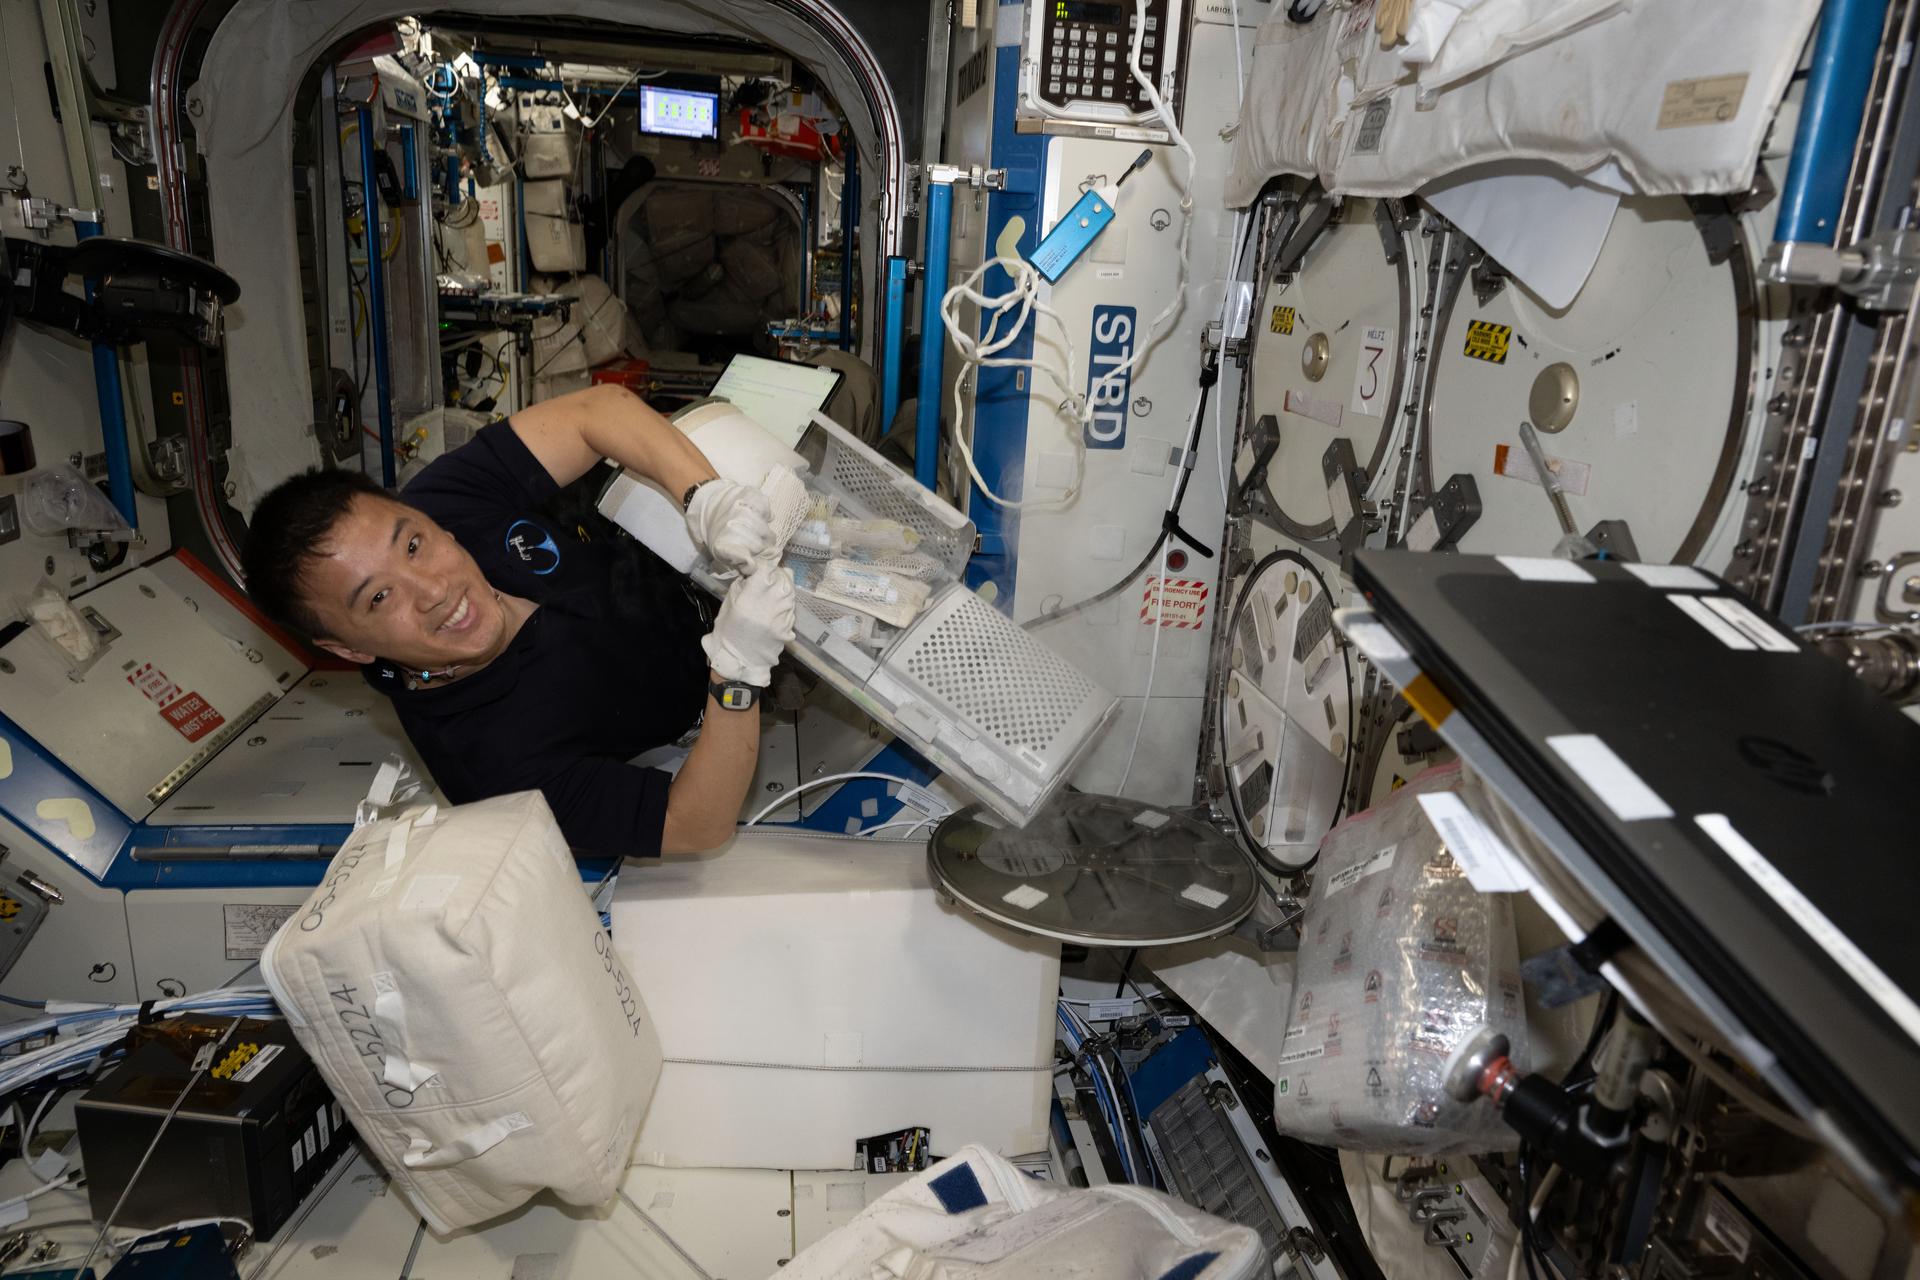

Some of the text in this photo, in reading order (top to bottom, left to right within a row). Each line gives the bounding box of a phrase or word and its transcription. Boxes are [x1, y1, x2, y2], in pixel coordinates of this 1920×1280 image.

[1088, 312, 1132, 442] STBD
[1360, 346, 1383, 400] 3
[1152, 586, 1188, 595] EMRGENCY
[1173, 600, 1197, 610] PORT
[169, 697, 204, 721] WATER
[180, 716, 204, 736] MIST
[595, 931, 641, 1039] 05-5224
